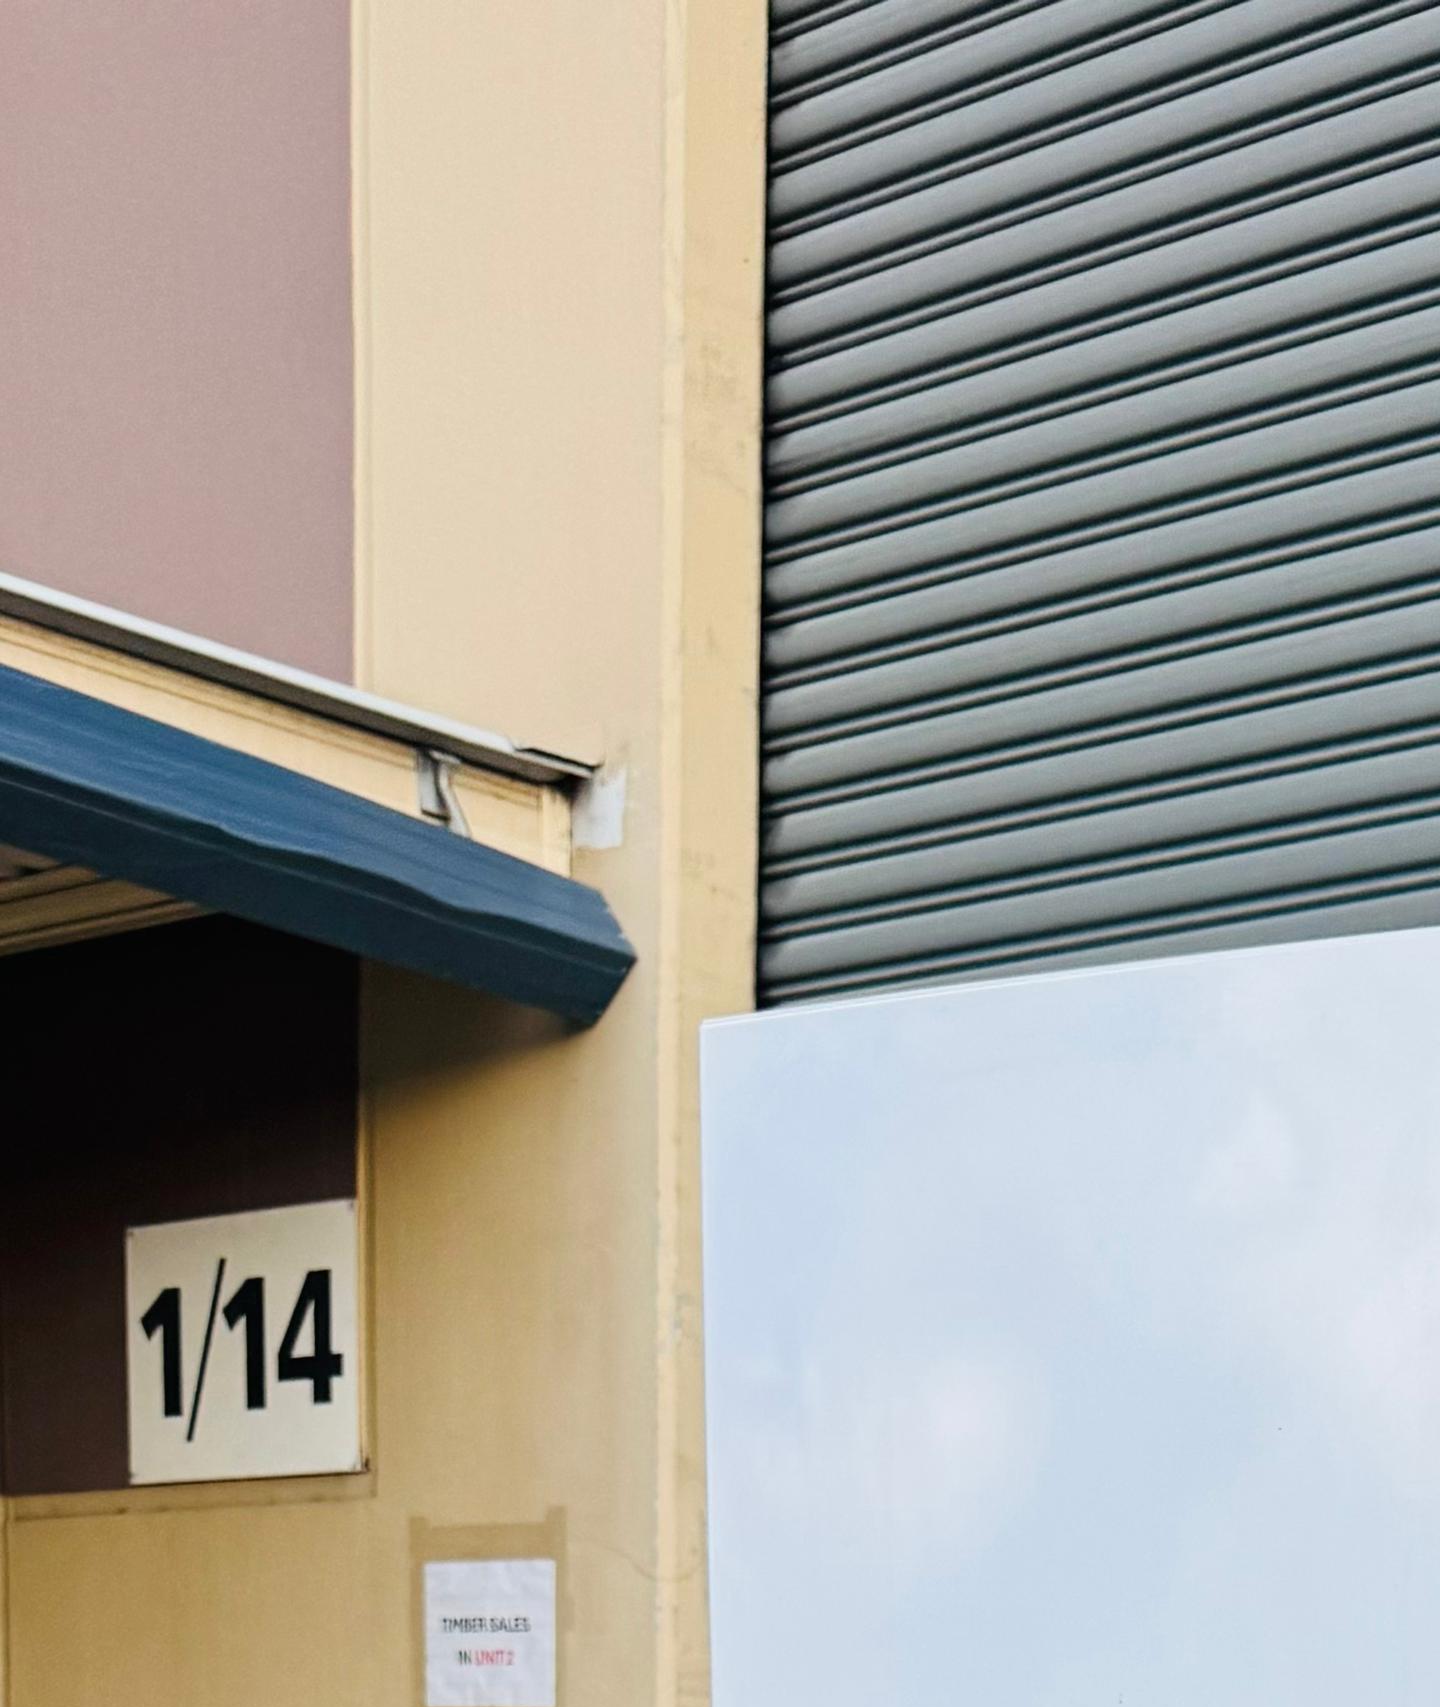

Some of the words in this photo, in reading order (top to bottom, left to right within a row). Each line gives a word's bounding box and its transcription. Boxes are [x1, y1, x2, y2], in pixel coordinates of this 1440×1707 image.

[140, 1258, 343, 1441] 1/14
[442, 1617, 487, 1633] TIMBER
[489, 1617, 531, 1633] SALES
[458, 1650, 471, 1665] IN
[473, 1650, 504, 1667] UNIT
